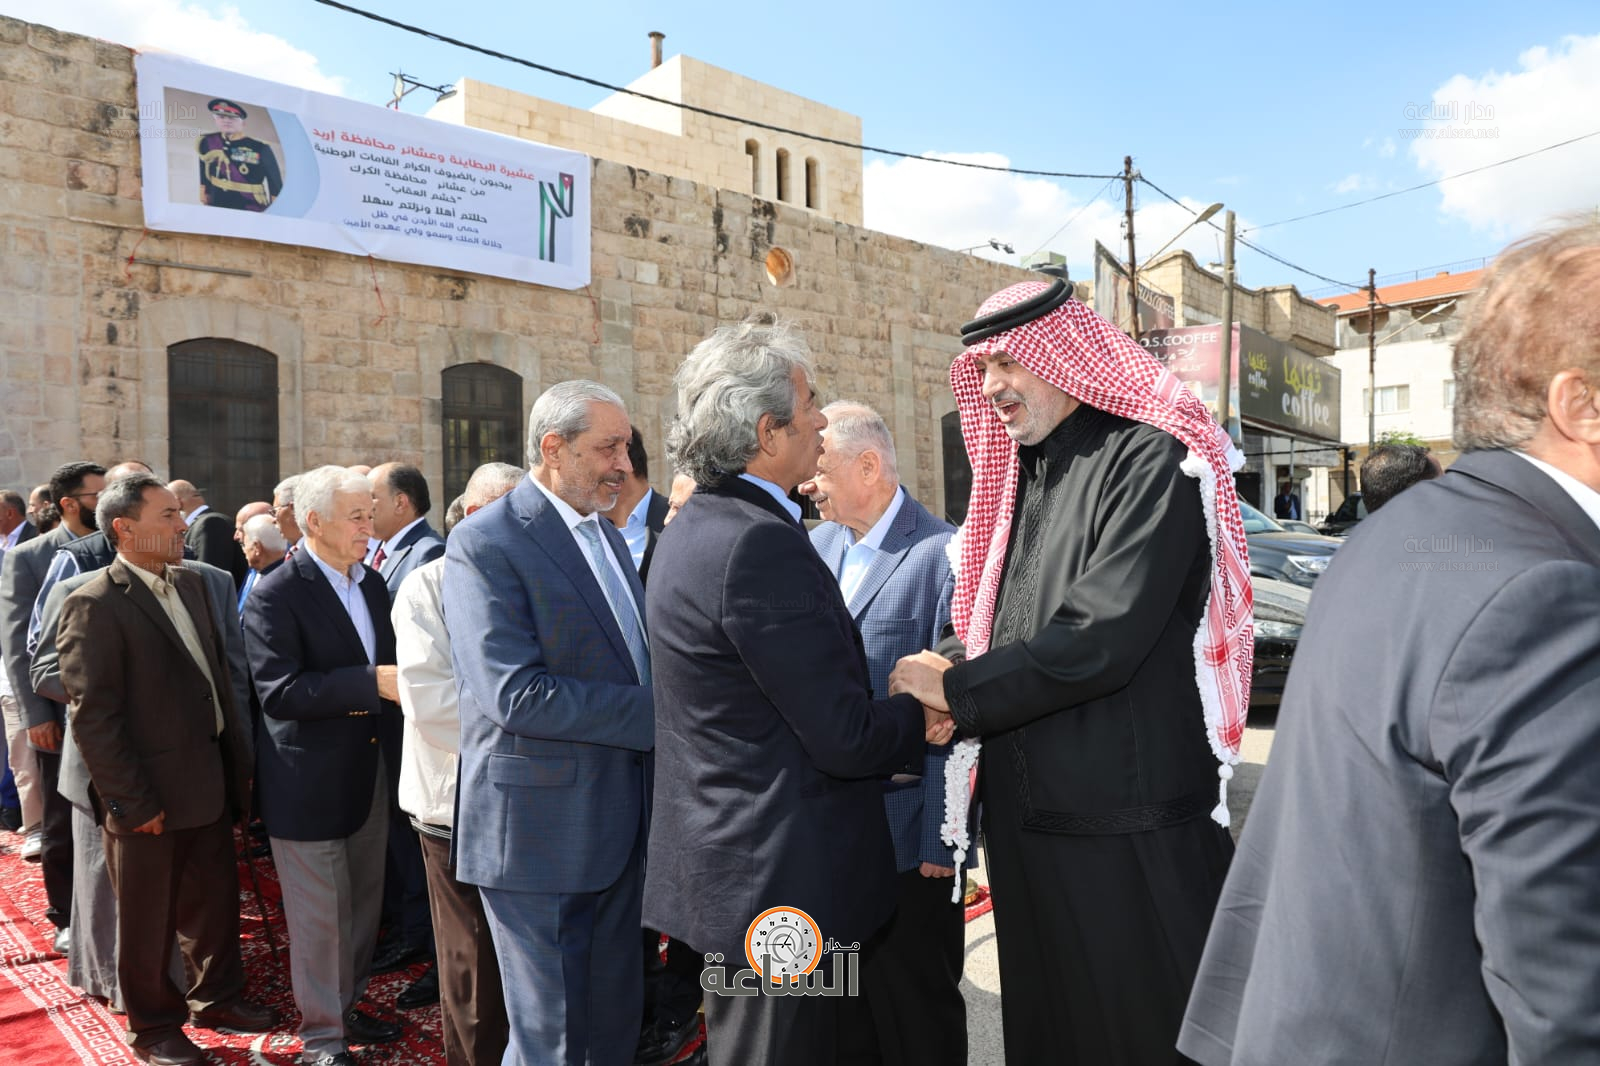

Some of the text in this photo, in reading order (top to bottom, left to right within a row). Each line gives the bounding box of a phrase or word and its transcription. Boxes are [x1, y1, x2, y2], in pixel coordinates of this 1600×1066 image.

[312, 128, 535, 181] عشيرة البطاينة وعشائر محافظة إربد
[314, 142, 513, 191] يرحبون بالضيوف الكرام القامات الوطنية
[350, 164, 486, 196] من عشائر محافظة الكرك
[361, 194, 394, 206] سهلا
[398, 202, 431, 215] ونزلتم
[371, 209, 480, 234] حمى الله الأردن في ظل
[460, 212, 488, 224] حللتم
[374, 223, 401, 232] عهده
[404, 227, 423, 237] ولي
[425, 230, 453, 241] وسمو
[455, 235, 480, 244] الملك
[1281, 388, 1330, 428] coffee
